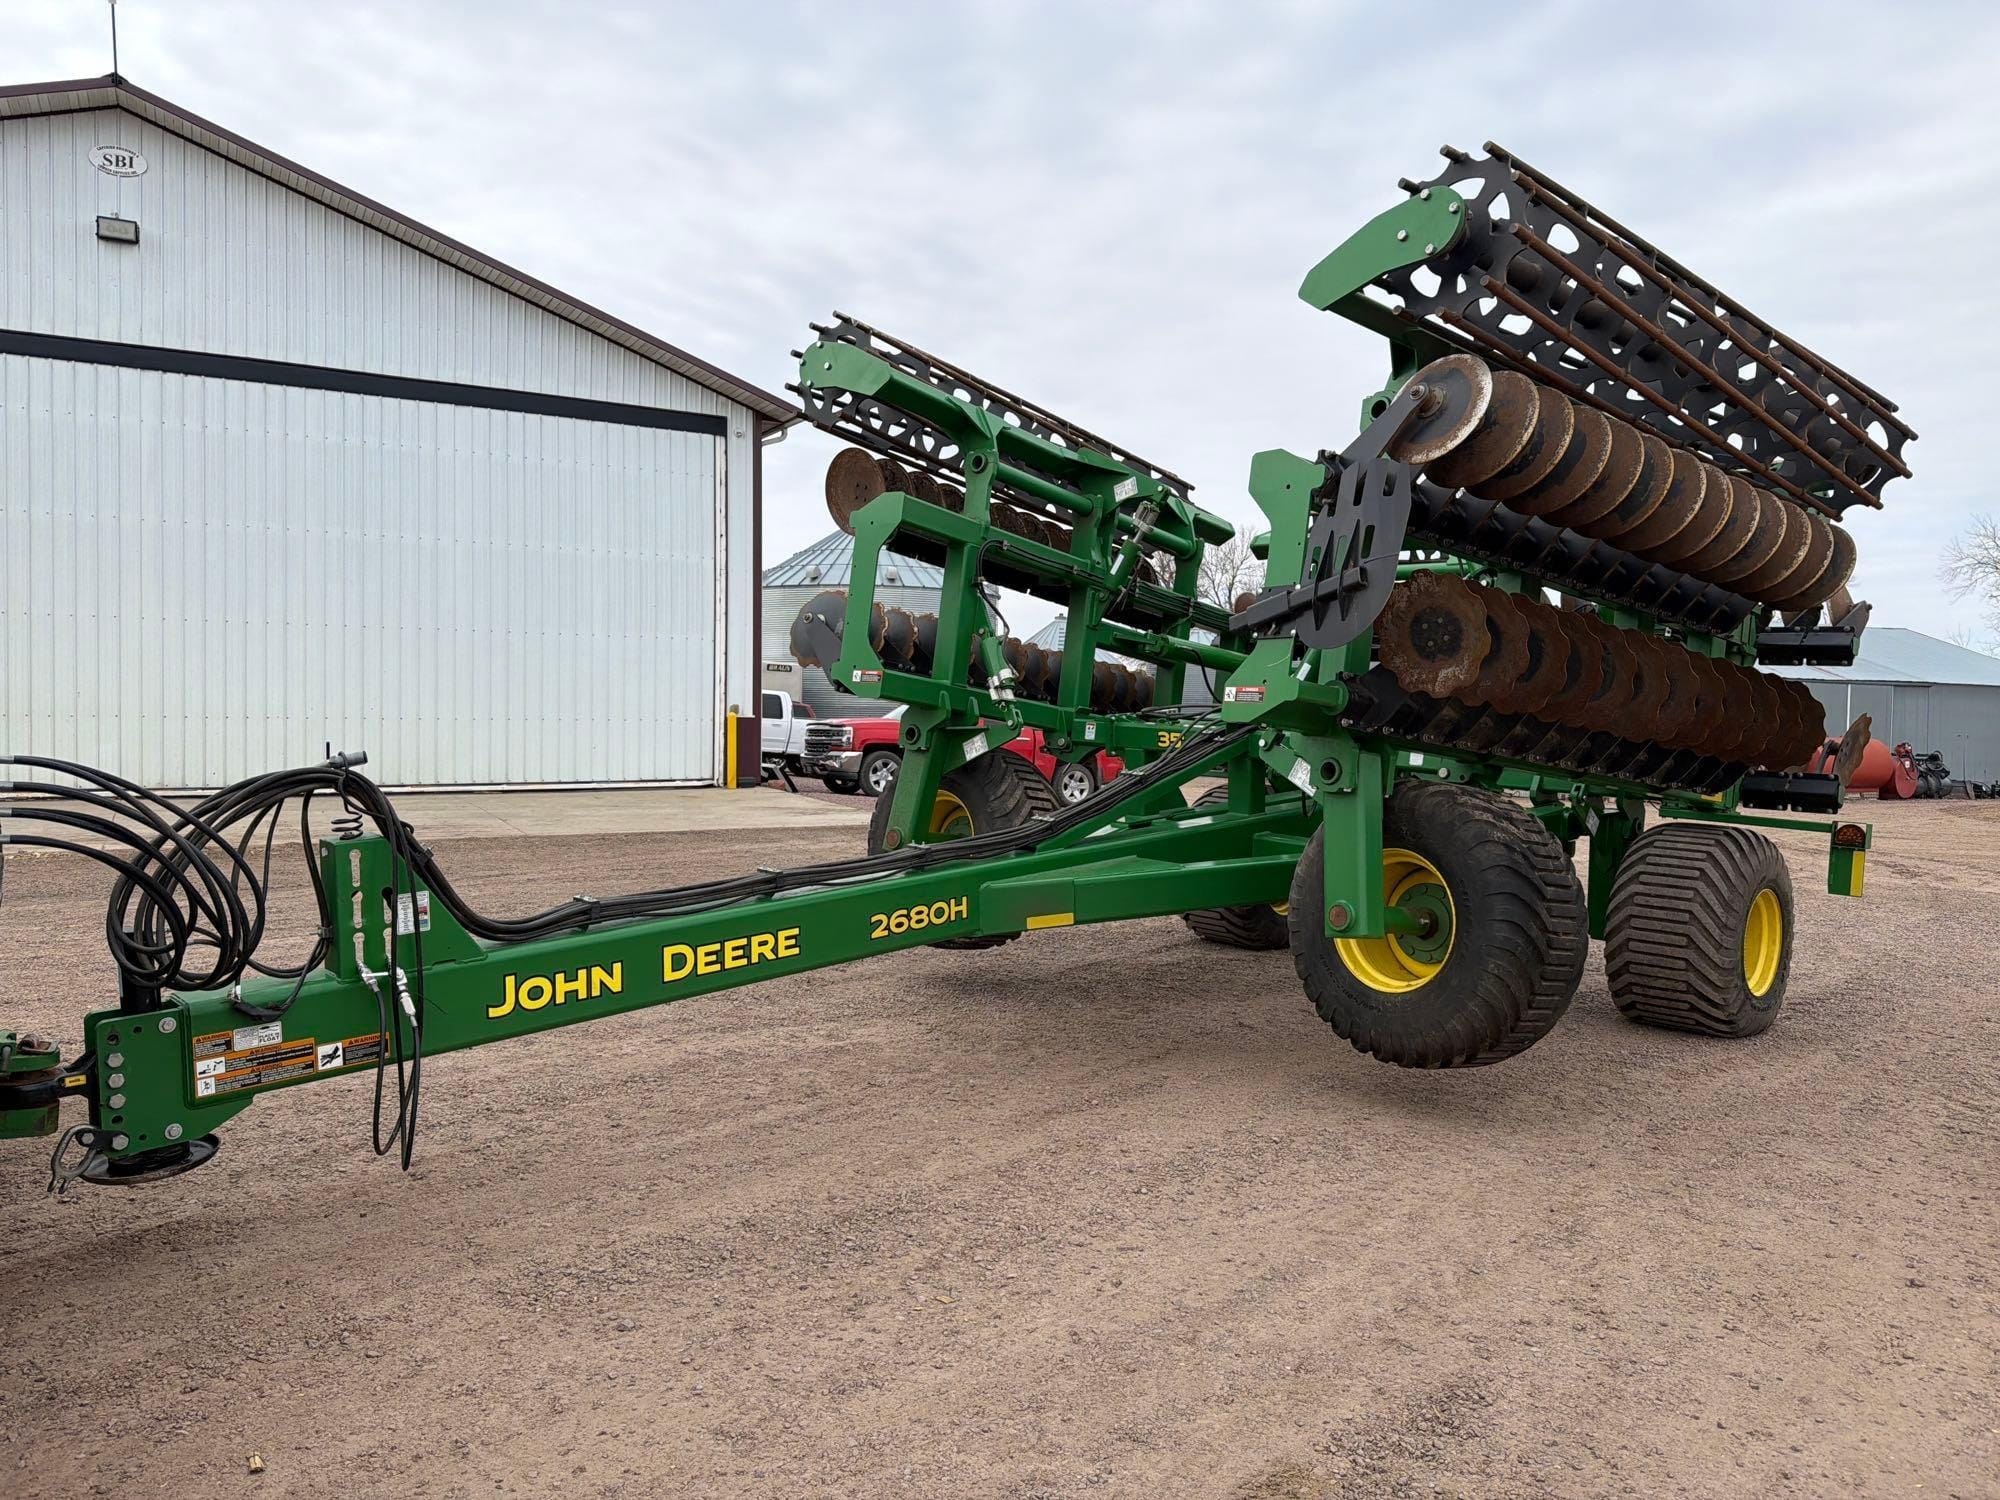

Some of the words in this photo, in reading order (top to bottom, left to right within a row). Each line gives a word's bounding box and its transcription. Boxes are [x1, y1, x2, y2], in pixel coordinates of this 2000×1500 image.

[103, 154, 134, 168] SBI
[869, 895, 969, 941] 2680H
[487, 960, 624, 1020] JOHN
[661, 927, 801, 984] DEERE
[201, 1032, 230, 1042] WARNING
[259, 1035, 280, 1043] FLOAT
[354, 1034, 381, 1043] WARNIN
[254, 1045, 282, 1053] WARNING
[256, 1062, 282, 1072] WARNING
